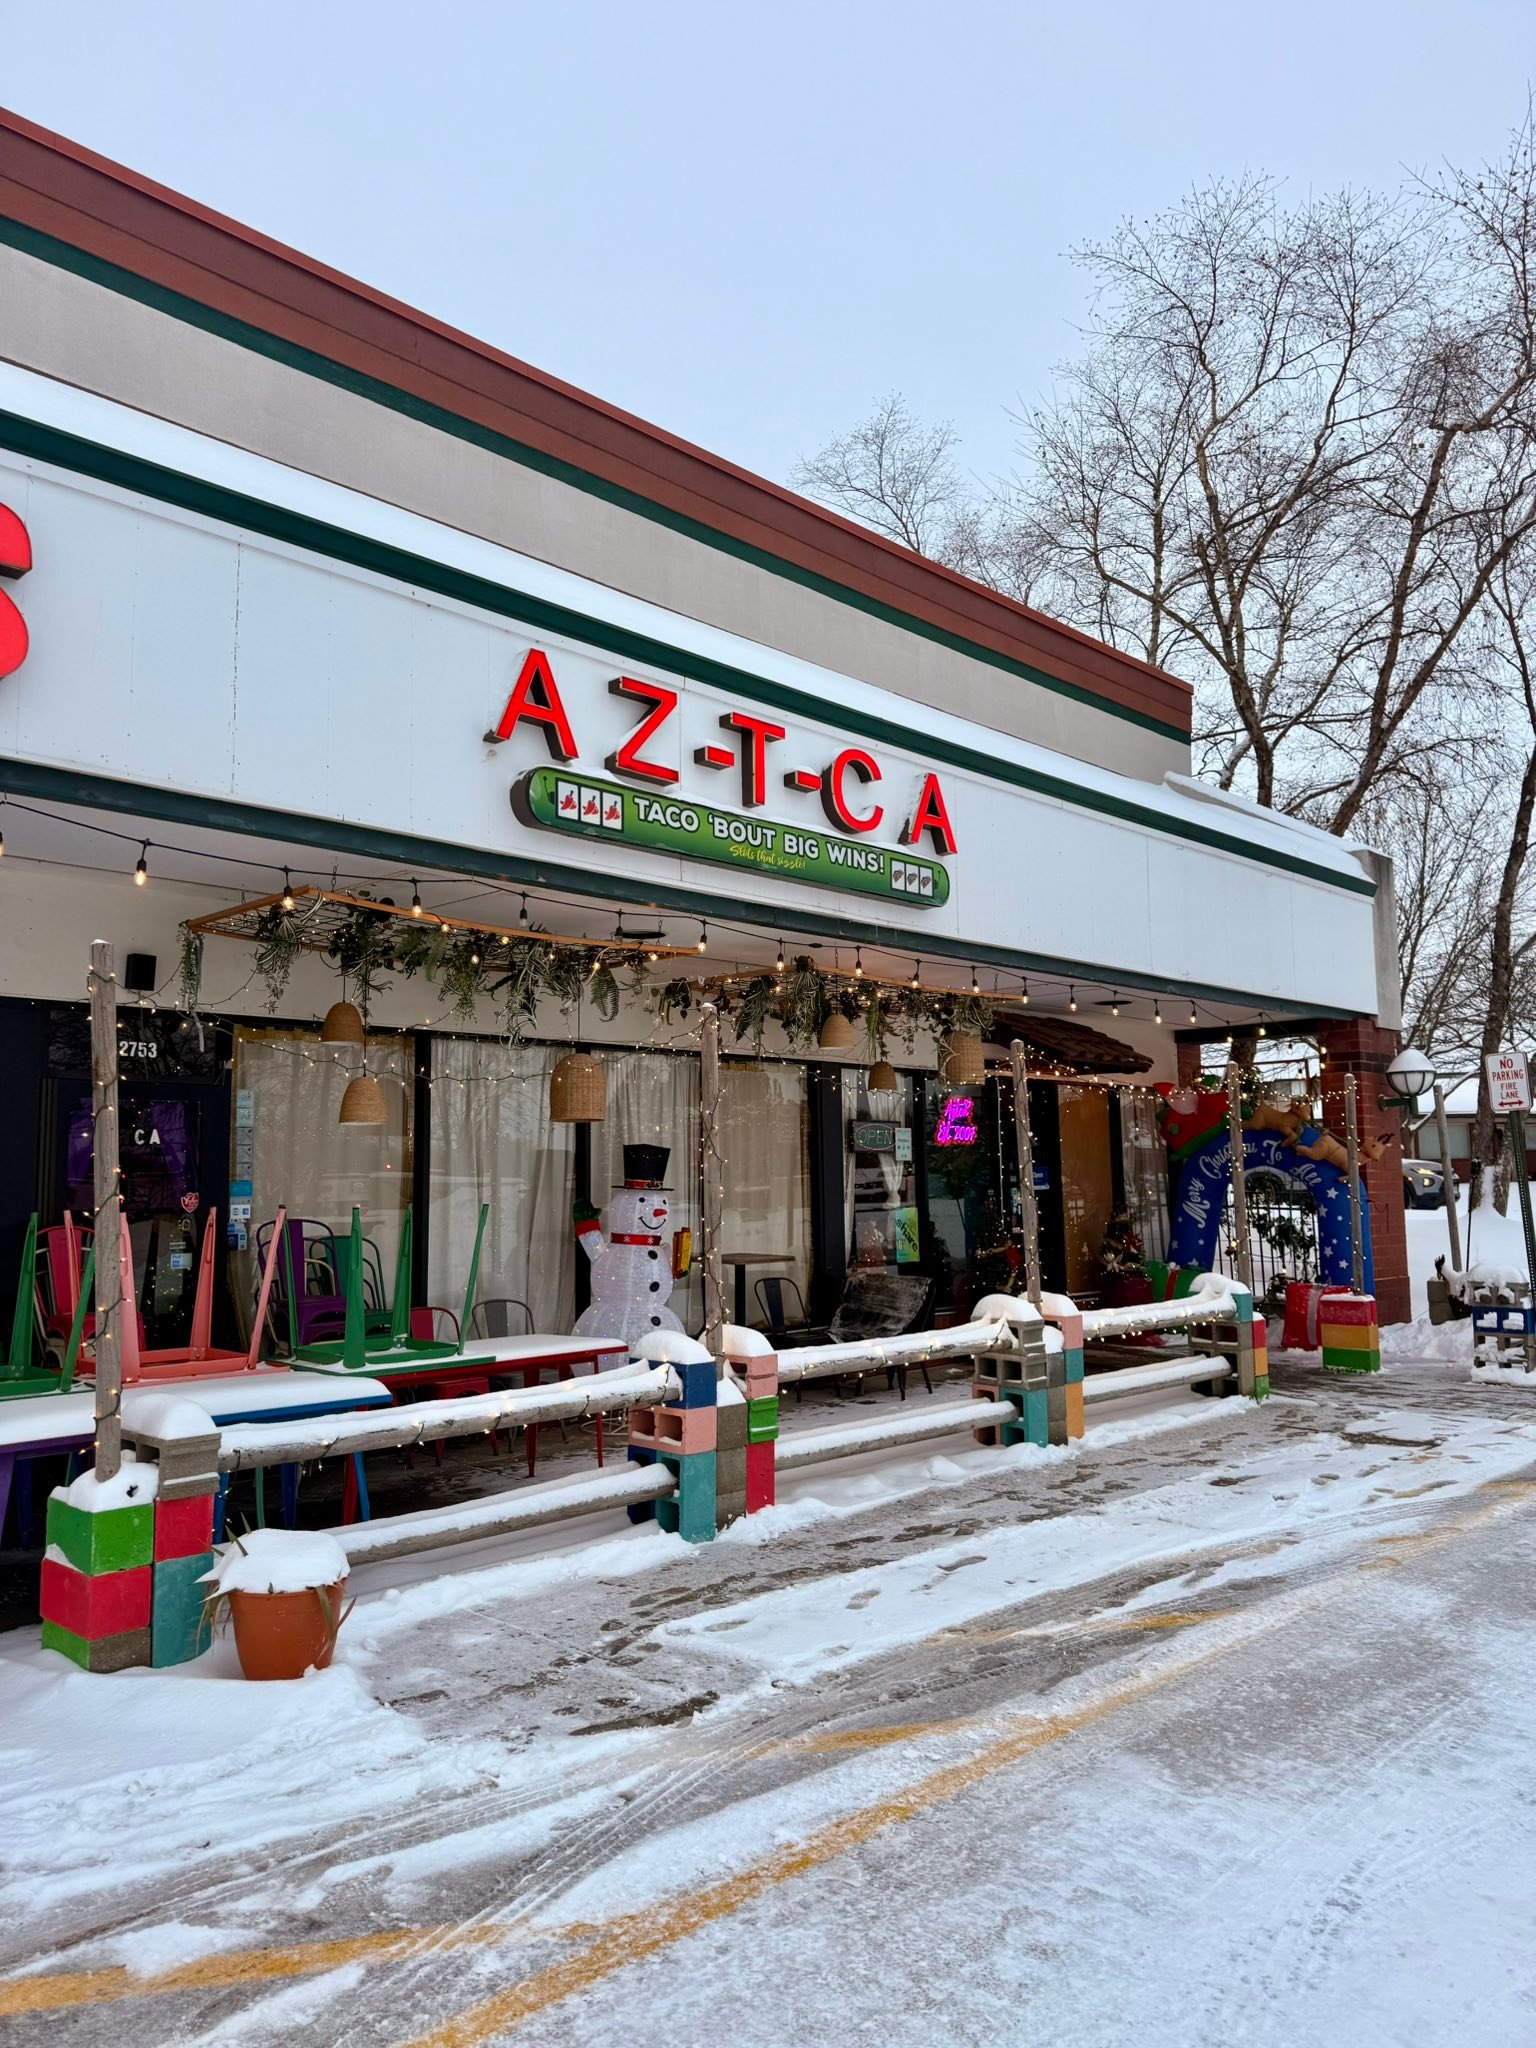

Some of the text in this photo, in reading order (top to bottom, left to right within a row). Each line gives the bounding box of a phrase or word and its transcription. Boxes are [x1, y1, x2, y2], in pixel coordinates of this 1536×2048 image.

[633, 797, 699, 833] TACO
[784, 833, 819, 859] BIG
[827, 843, 885, 873] WINS!
[730, 845, 806, 870] Slots that sizzle!
[119, 1041, 158, 1058] 2753
[1500, 1058, 1514, 1069] NO
[1492, 1070, 1524, 1081] PARKING
[1501, 1082, 1518, 1091] FIRE
[1501, 1091, 1520, 1100] LANE
[859, 1129, 894, 1145] OPEN
[1182, 1176, 1211, 1229] Merry
[1262, 1139, 1283, 1165] To
[1290, 1163, 1322, 1187] All
[896, 1218, 918, 1252] share
